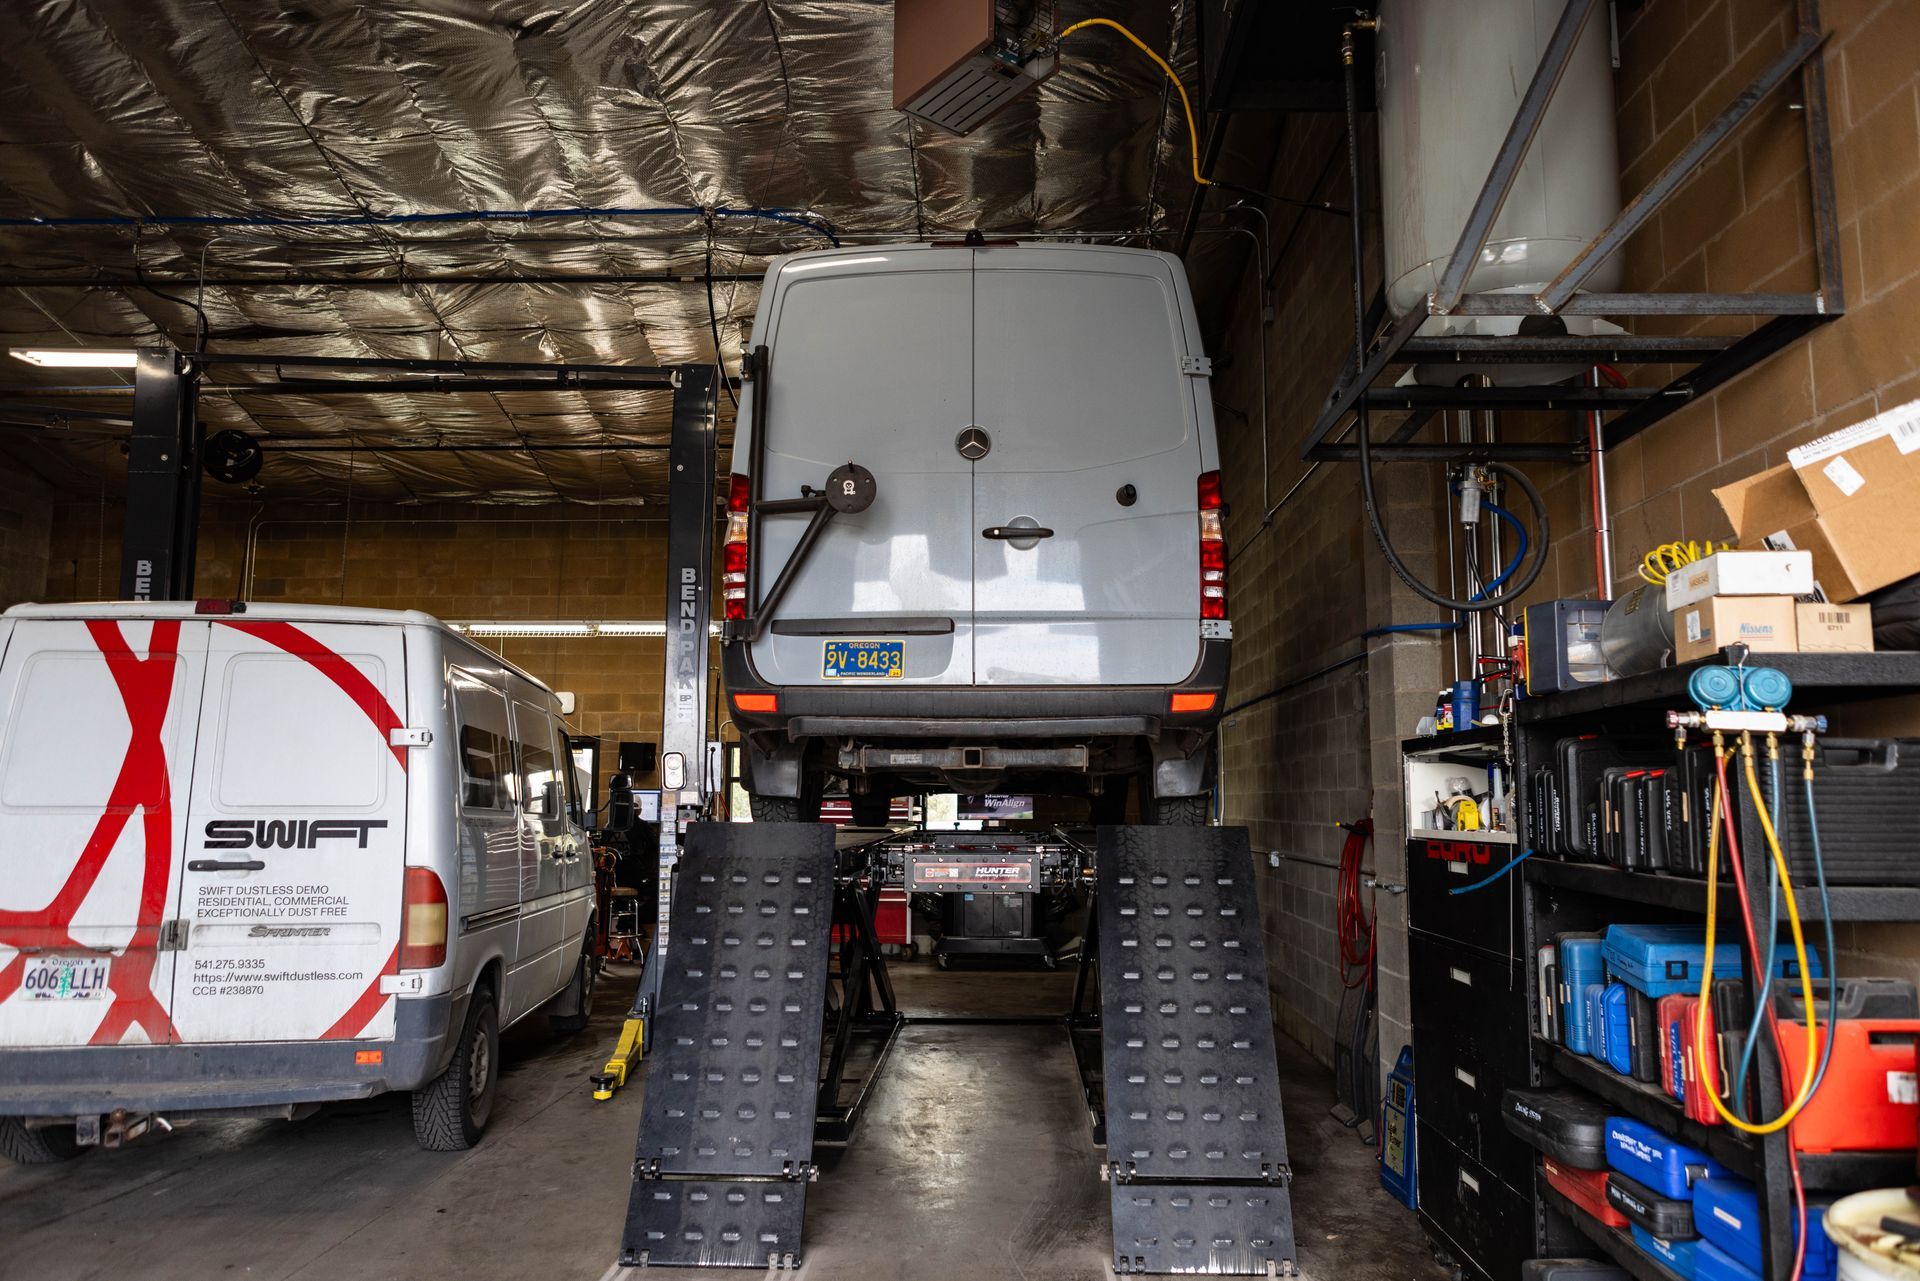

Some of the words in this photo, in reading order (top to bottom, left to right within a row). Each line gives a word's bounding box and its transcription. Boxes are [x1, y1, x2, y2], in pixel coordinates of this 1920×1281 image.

[1739, 623, 1774, 634] Nissens
[826, 651, 901, 669] 9V-8433
[984, 799, 1025, 808] WinAlign
[204, 820, 388, 849] SWIFT
[198, 886, 234, 896] SWIFT
[236, 886, 293, 895] DUSTLESS
[296, 885, 329, 895] DEMO
[198, 897, 272, 907] RESIDENTIAL,
[274, 896, 349, 906] COMMERCIAL
[197, 908, 286, 918] EXCEPTIONALLY
[288, 907, 318, 917] DUST
[320, 907, 348, 916] FREE
[52, 959, 83, 967] Oregon
[194, 959, 265, 970] 541.275.9335
[25, 968, 59, 989] 606
[70, 968, 105, 989] LLH
[193, 971, 363, 985] https://www.swiftdustless.com
[192, 987, 217, 996] CCB
[219, 986, 264, 995] #238870
